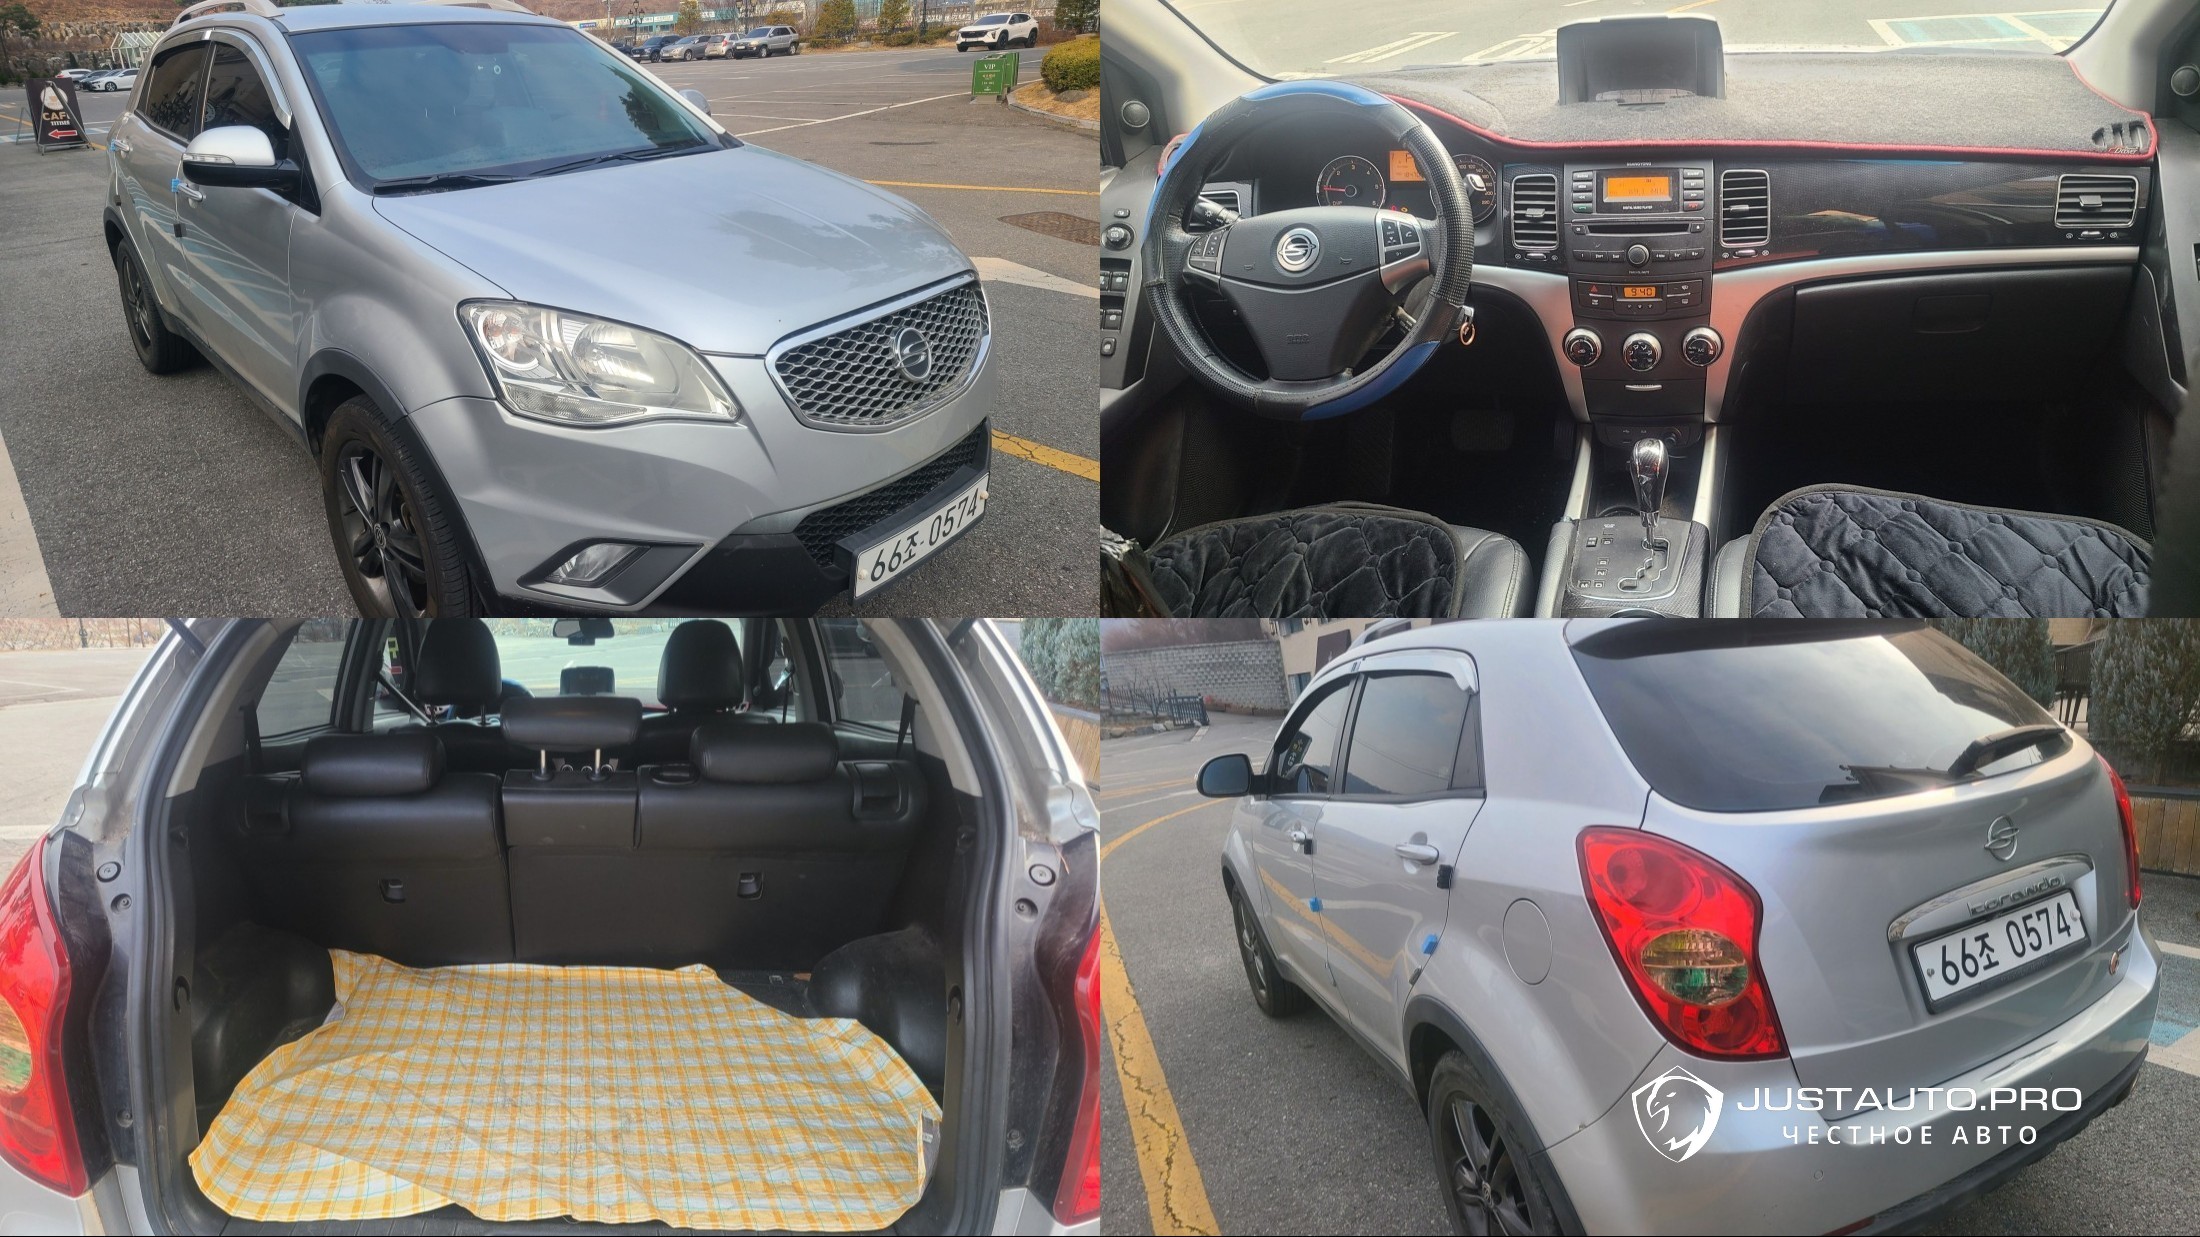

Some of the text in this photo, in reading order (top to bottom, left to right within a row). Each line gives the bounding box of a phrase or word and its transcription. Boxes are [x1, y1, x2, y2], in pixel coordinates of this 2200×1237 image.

[42, 111, 71, 121] CAF
[1631, 288, 1653, 297] 9:40
[870, 487, 979, 582] 66조 0574
[1941, 932, 1999, 986] 66조
[2005, 902, 2072, 958] 0574
